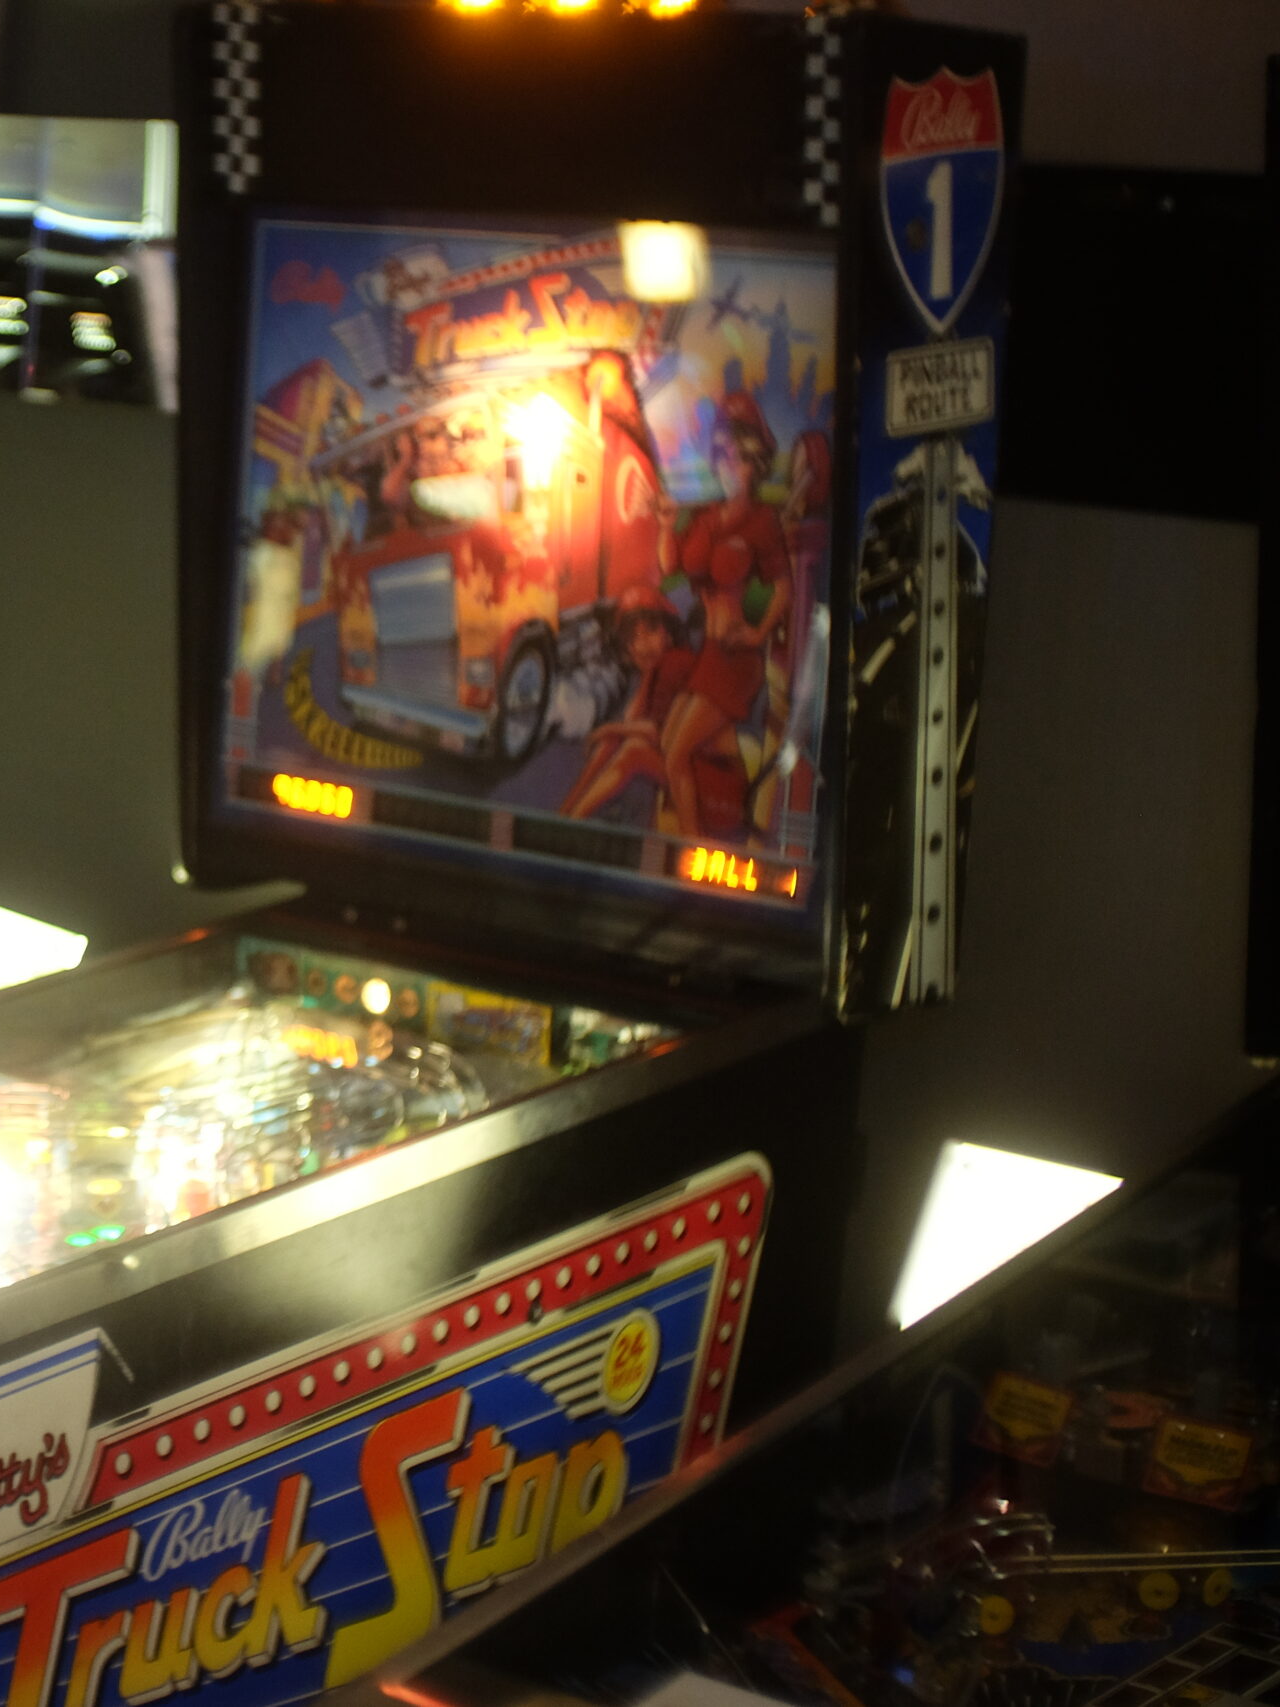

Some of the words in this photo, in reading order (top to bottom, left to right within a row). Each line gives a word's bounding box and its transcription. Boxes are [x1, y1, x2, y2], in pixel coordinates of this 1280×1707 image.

[926, 161, 953, 300] 1
[900, 350, 984, 389] PINBALL
[904, 386, 974, 423] ROUTE
[613, 1328, 646, 1370] 24
[139, 1487, 268, 1582] Bally
[323, 1386, 629, 1689] Stop
